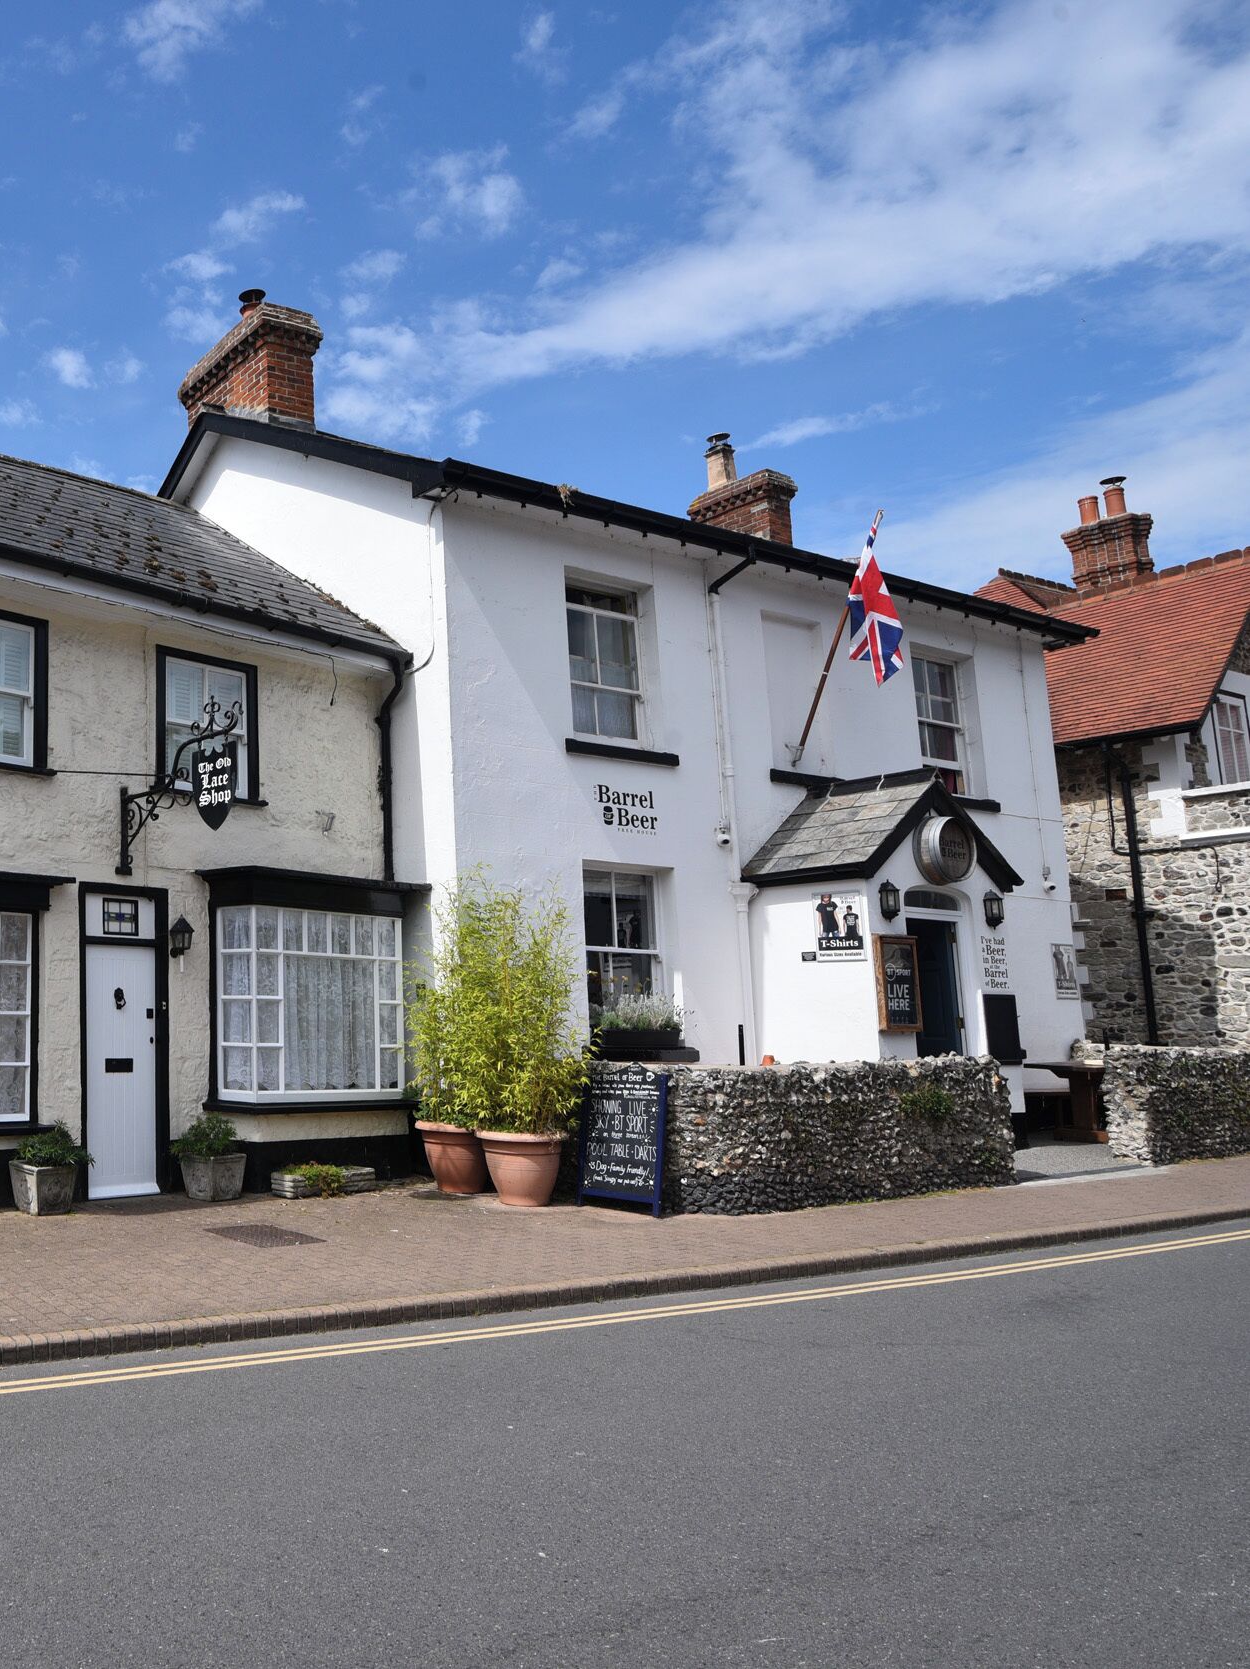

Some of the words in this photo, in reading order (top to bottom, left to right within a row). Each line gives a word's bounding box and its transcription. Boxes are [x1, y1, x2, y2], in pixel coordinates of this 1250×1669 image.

[198, 762, 214, 774] The
[215, 756, 232, 769] Old
[200, 773, 229, 790] Lace
[198, 789, 232, 807] Shop
[597, 784, 654, 809] Barrel
[616, 807, 658, 830] Beer
[820, 939, 859, 948] T-Shirts
[980, 936, 992, 944] I've
[993, 937, 1005, 945] had
[986, 945, 1006, 957] Beer,
[982, 955, 989, 963] in
[990, 956, 1007, 966] Beer,
[984, 968, 1008, 978] Barrel
[887, 984, 910, 998] LIVE
[990, 979, 1010, 989] Beer.
[888, 998, 911, 1011] HERE
[628, 1072, 643, 1081] Beer
[590, 1099, 622, 1114] SHOWING
[628, 1101, 647, 1116] LIVE
[595, 1114, 610, 1129] SKY
[614, 1115, 625, 1130] BT
[626, 1115, 649, 1133] SPORT
[586, 1142, 608, 1156] POOL
[610, 1143, 630, 1158] TABLE
[634, 1145, 657, 1162] DARTS
[596, 1160, 607, 1174] Dog
